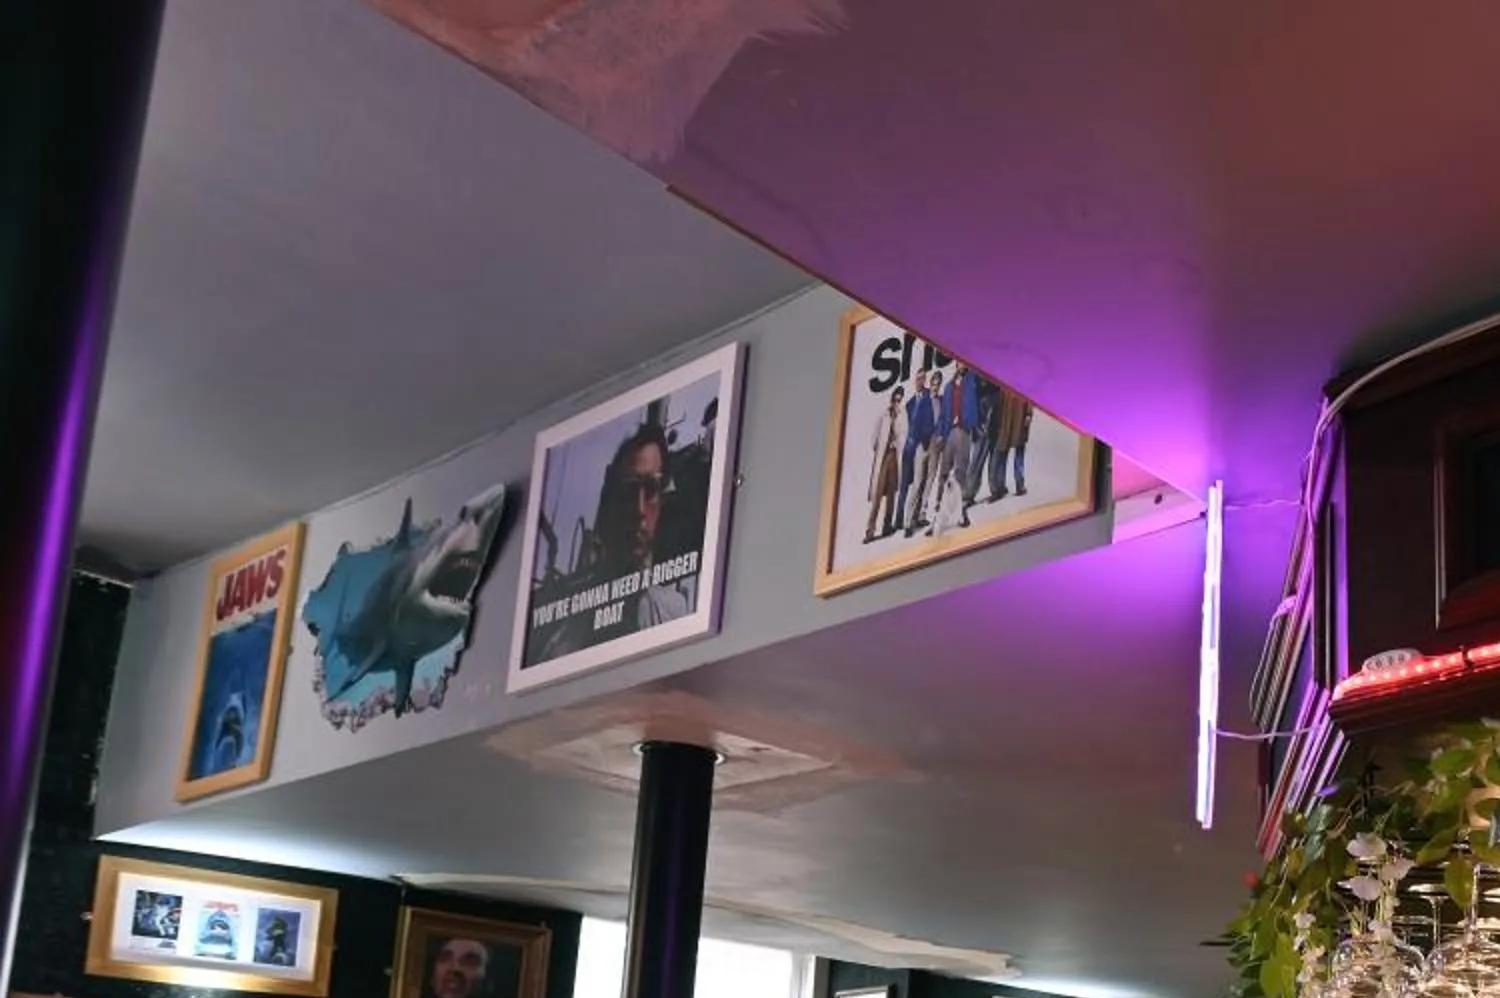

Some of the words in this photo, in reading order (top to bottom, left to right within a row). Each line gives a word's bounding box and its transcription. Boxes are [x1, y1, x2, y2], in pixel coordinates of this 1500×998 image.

[216, 549, 286, 621] JAWS
[533, 597, 570, 629] YOU'RE
[571, 582, 609, 615] GONNA
[611, 572, 640, 599] NEED
[641, 568, 651, 589] A
[652, 551, 698, 585] BIGGER
[593, 601, 624, 630] BOAT
